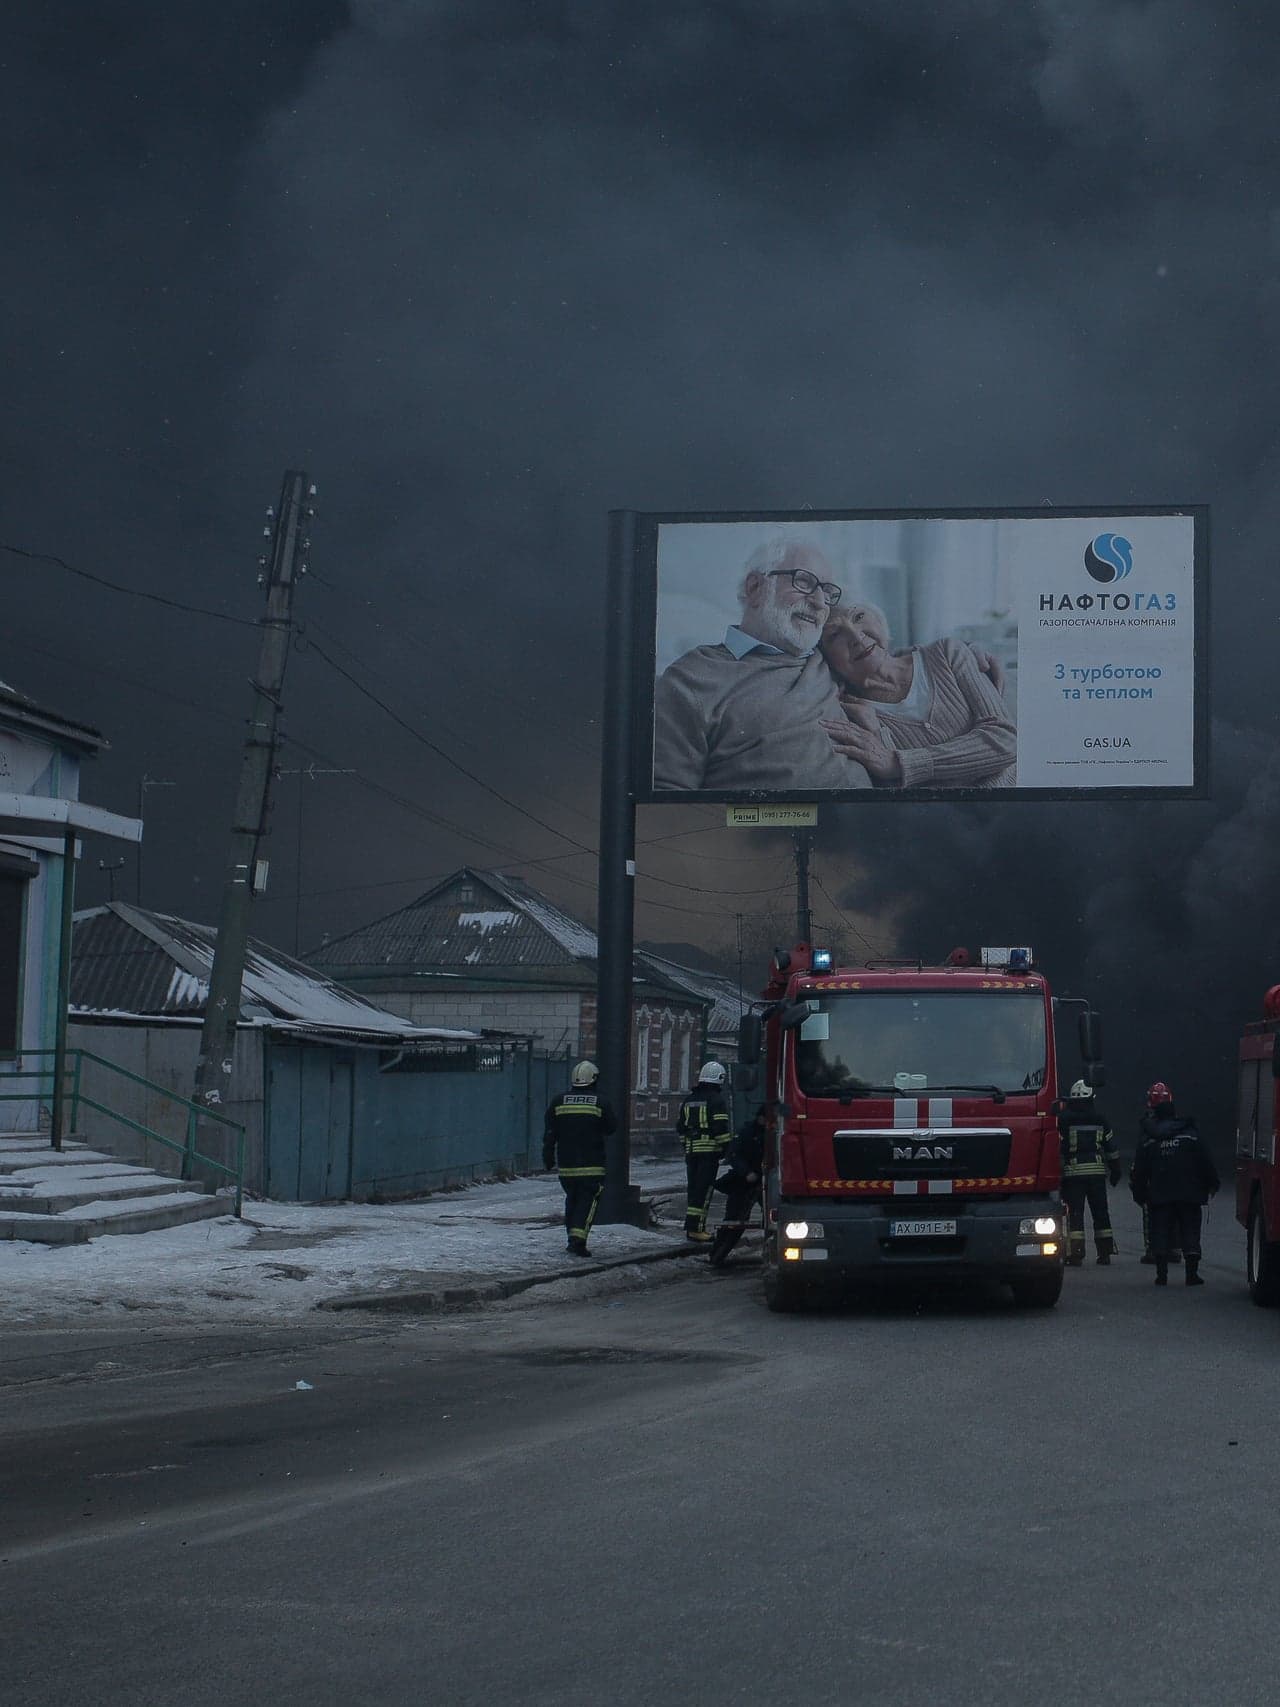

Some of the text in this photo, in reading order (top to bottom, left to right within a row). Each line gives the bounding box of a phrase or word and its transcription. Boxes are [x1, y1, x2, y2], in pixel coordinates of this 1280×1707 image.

[1039, 593, 1176, 611] НАФТОГАЗ
[1039, 618, 1176, 627] ГАЗОПОСТАЧАЛЬНА КОМПАНІЯ
[1054, 664, 1162, 683] З турботою
[1062, 687, 1153, 700] та теплом
[1083, 738, 1131, 748] GAS.UA
[565, 1096, 594, 1104] FIRE
[893, 1146, 953, 1160] MAN
[897, 1223, 911, 1234] AX
[914, 1223, 932, 1233] 091
